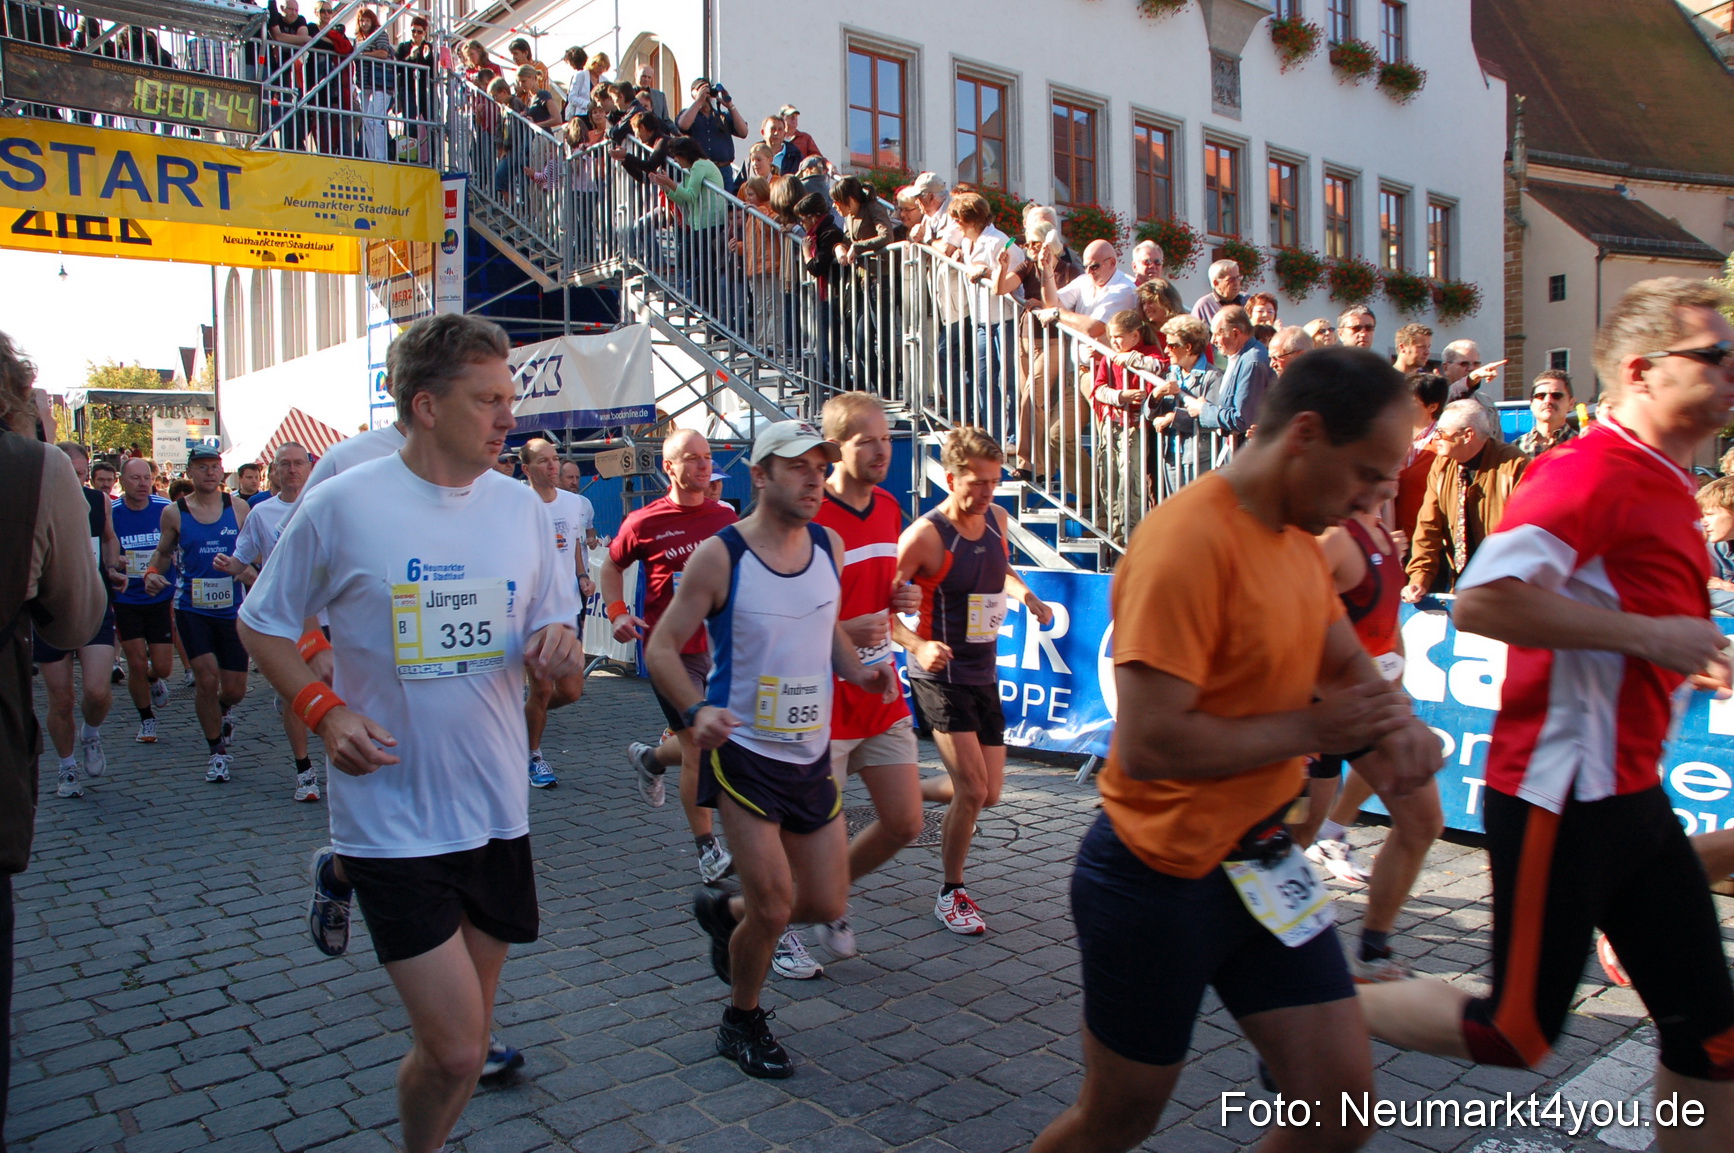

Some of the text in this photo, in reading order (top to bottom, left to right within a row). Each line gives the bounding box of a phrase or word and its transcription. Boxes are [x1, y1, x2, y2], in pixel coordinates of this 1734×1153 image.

[92, 59, 251, 93] Elektronische Sportstätteneinrichtungen
[133, 78, 254, 126] 10:00:44
[0, 137, 242, 211] START
[283, 196, 411, 217] Neumarkter Stadtlauf
[223, 235, 335, 252] Neumarkter Stadtlauf
[120, 532, 160, 545] HUBER
[199, 546, 228, 554] München
[423, 563, 465, 573] Neumarkter
[432, 572, 465, 582] Stadtlauf
[205, 590, 231, 602] 1006
[426, 590, 477, 610] Jürgen
[398, 620, 407, 634] B
[440, 620, 492, 649] 335
[398, 663, 444, 675] BOCK
[787, 704, 819, 724] 856
